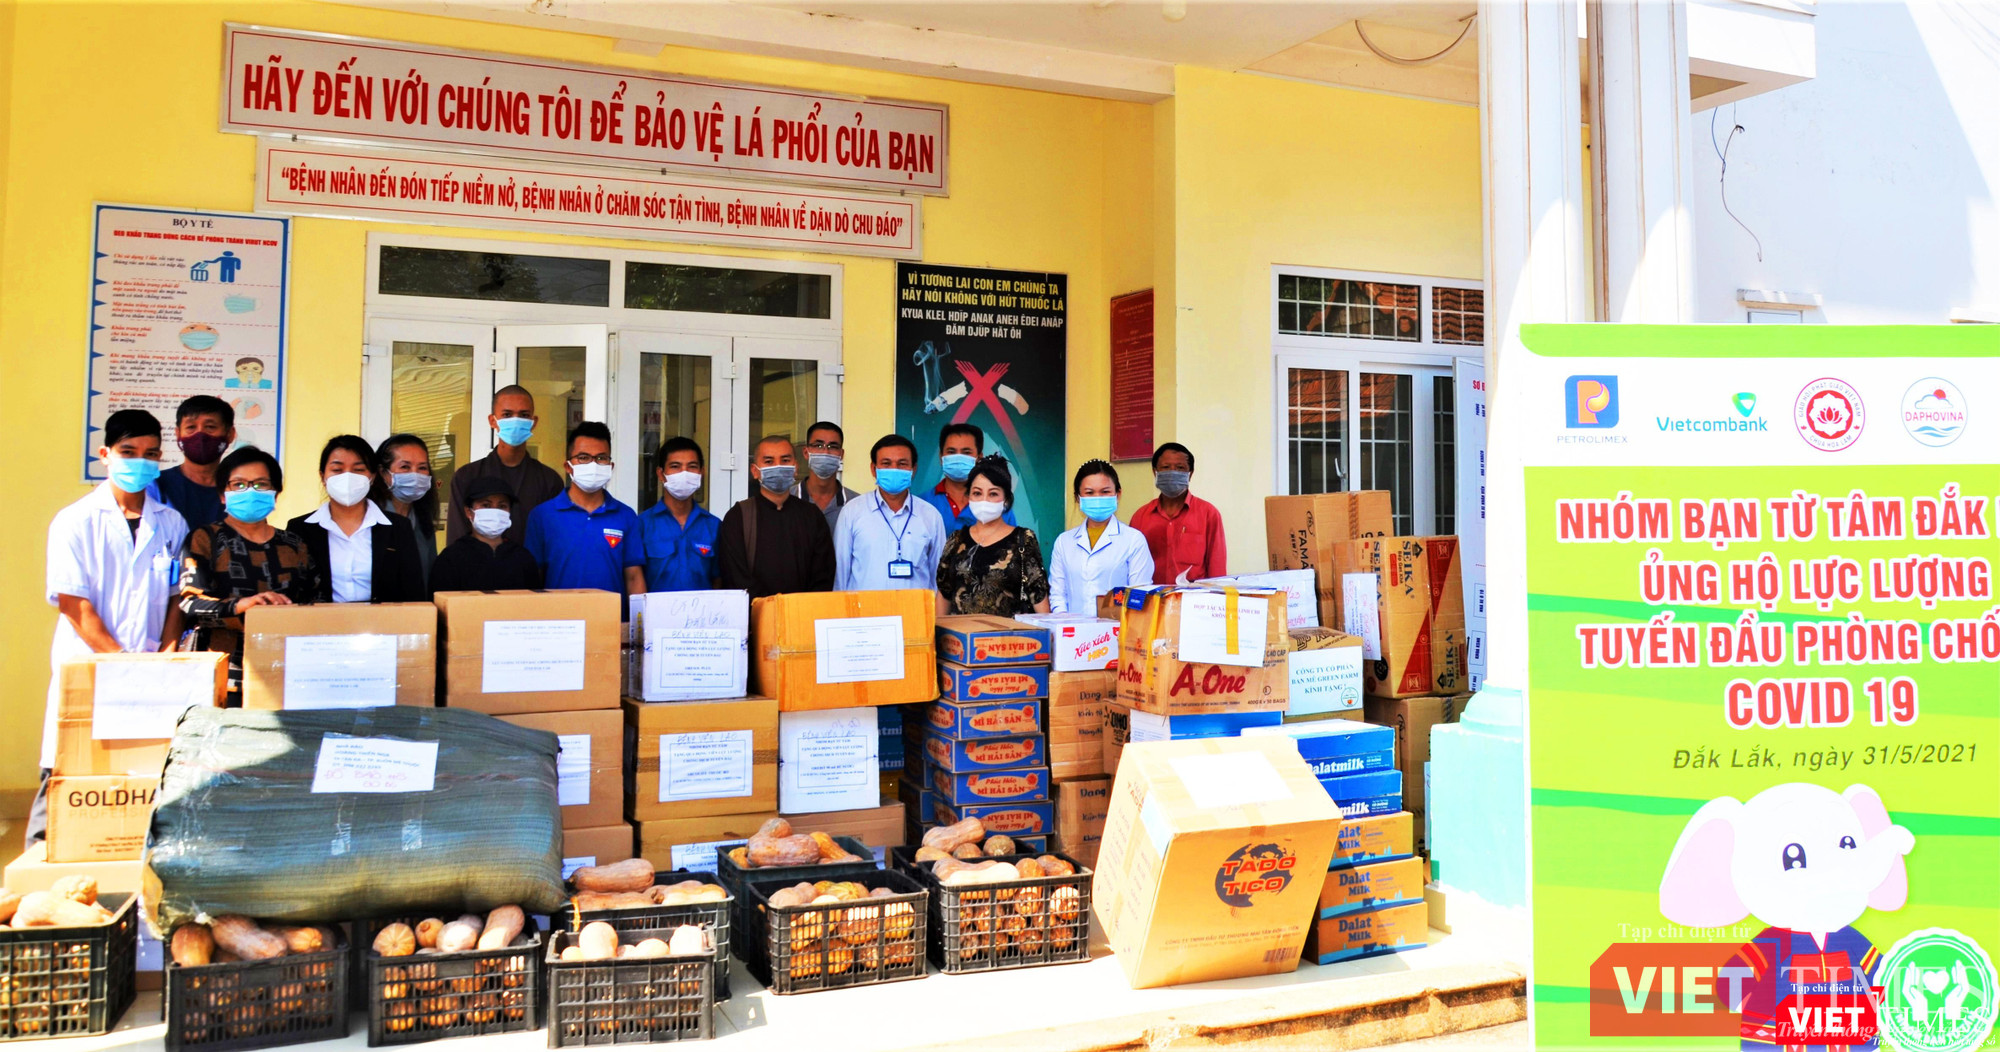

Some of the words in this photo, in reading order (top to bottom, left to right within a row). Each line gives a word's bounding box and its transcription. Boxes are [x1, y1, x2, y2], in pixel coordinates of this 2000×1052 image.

[243, 57, 304, 112] HÃY
[312, 63, 373, 120] ĐẾN
[382, 70, 429, 124] VỚI
[438, 77, 530, 135] CHÚNG
[538, 85, 581, 140] TÔI
[590, 90, 625, 144] ĐỂ
[635, 93, 685, 150] BẢO
[693, 101, 724, 160] VỆ
[734, 106, 763, 157] LÁ
[772, 108, 827, 163] PHỔI
[835, 112, 880, 168] CỦA
[888, 127, 934, 178] BẠN
[281, 163, 326, 194] “BỆNH
[330, 167, 366, 194] NHÂN
[369, 169, 396, 197] ĐẾN
[400, 176, 427, 199] ĐÓN
[430, 174, 459, 202] TIẾP
[463, 177, 494, 204] NIỀM
[498, 179, 518, 208] NỞ,
[522, 182, 555, 210] BỆNH
[559, 185, 591, 212] NHÂN
[594, 186, 603, 213] Ở
[606, 191, 640, 216] CHĂM
[643, 196, 666, 218] SÓC
[669, 194, 691, 219] TẬN
[694, 200, 723, 222] TÌNH,
[727, 199, 756, 225] BỆNH
[760, 202, 789, 227] NHÂN
[792, 204, 806, 229] VỀ
[810, 208, 831, 230] DẶN
[835, 212, 848, 232] DÒ
[852, 214, 872, 234] CHU
[876, 216, 902, 236] ĐÁO”
[172, 218, 188, 228] BỘ
[190, 219, 196, 227] Y
[200, 219, 213, 229] TẾ
[908, 271, 918, 285] VÌ
[920, 273, 952, 288] TƯƠNG
[956, 276, 970, 289] LAI
[973, 278, 993, 290] CON
[996, 279, 1010, 292] EM
[1014, 280, 1045, 294] CHÚNG
[1048, 284, 1058, 295] TA
[902, 286, 921, 300] HÃY
[924, 290, 941, 302] NÓI
[944, 290, 977, 304] KHÔNG
[980, 292, 995, 306] VỚI
[999, 294, 1016, 307] HÚT
[1020, 296, 1048, 309] THUỐC
[1052, 298, 1063, 310] LÁ
[902, 308, 922, 318] KYUA
[970, 312, 993, 323] ANAK
[996, 314, 1018, 325] ANEH
[1656, 416, 1768, 432] Vietcombank
[1905, 411, 1964, 422] DAPHOVINA
[1557, 435, 1628, 444] PETROLIMEX
[1560, 494, 1668, 538] NHÓM
[1684, 502, 1757, 547] BẠN
[1771, 493, 1816, 537] TỪ
[1827, 493, 1901, 537] TÂM
[1916, 481, 1985, 536] ĐẮK
[1403, 540, 1414, 595] SEIKA
[1644, 551, 1718, 601] ỦNG
[1733, 556, 1777, 608] HỘ
[1794, 559, 1858, 607] LỰC
[1874, 558, 1987, 605] LƯỢNG
[1579, 614, 1696, 664] TUYẾN
[1710, 612, 1782, 664] ĐẦU
[1798, 614, 1919, 663] PHÒNG
[988, 643, 1006, 654] SẢN
[1009, 643, 1024, 654] HẢI
[1027, 642, 1038, 651] MÌ
[1074, 640, 1092, 660] Xúc
[1093, 632, 1110, 647] xích
[1087, 647, 1109, 662] HEO
[1446, 634, 1454, 688] SEIKA
[1019, 675, 1028, 683] MÌ
[1118, 662, 1142, 684] A-One
[1170, 663, 1246, 696] A-One
[981, 677, 999, 686] SẢN
[1001, 676, 1016, 686] HẢI
[1728, 681, 1849, 726] COVID
[1868, 680, 1914, 722] 19
[974, 718, 984, 727] MÌ
[1005, 713, 1022, 724] SẢN
[976, 754, 986, 762] MÌ
[988, 752, 1003, 761] HẢI
[1005, 751, 1022, 759] SẢN
[1673, 745, 1720, 768] Đắk
[1730, 744, 1782, 769] Lắk,
[1793, 745, 1854, 771] ngày
[1862, 743, 1977, 765] 31/5/2021
[990, 785, 1004, 794] HẢI
[1007, 784, 1025, 793] SẢN
[1338, 840, 1361, 850] Milk
[1221, 856, 1296, 876] TADO
[1224, 876, 1284, 895] TICO
[1339, 872, 1370, 886] Dalat
[1348, 886, 1370, 896] Milk
[1338, 918, 1372, 932] Dalat
[1348, 931, 1371, 942] Milk
